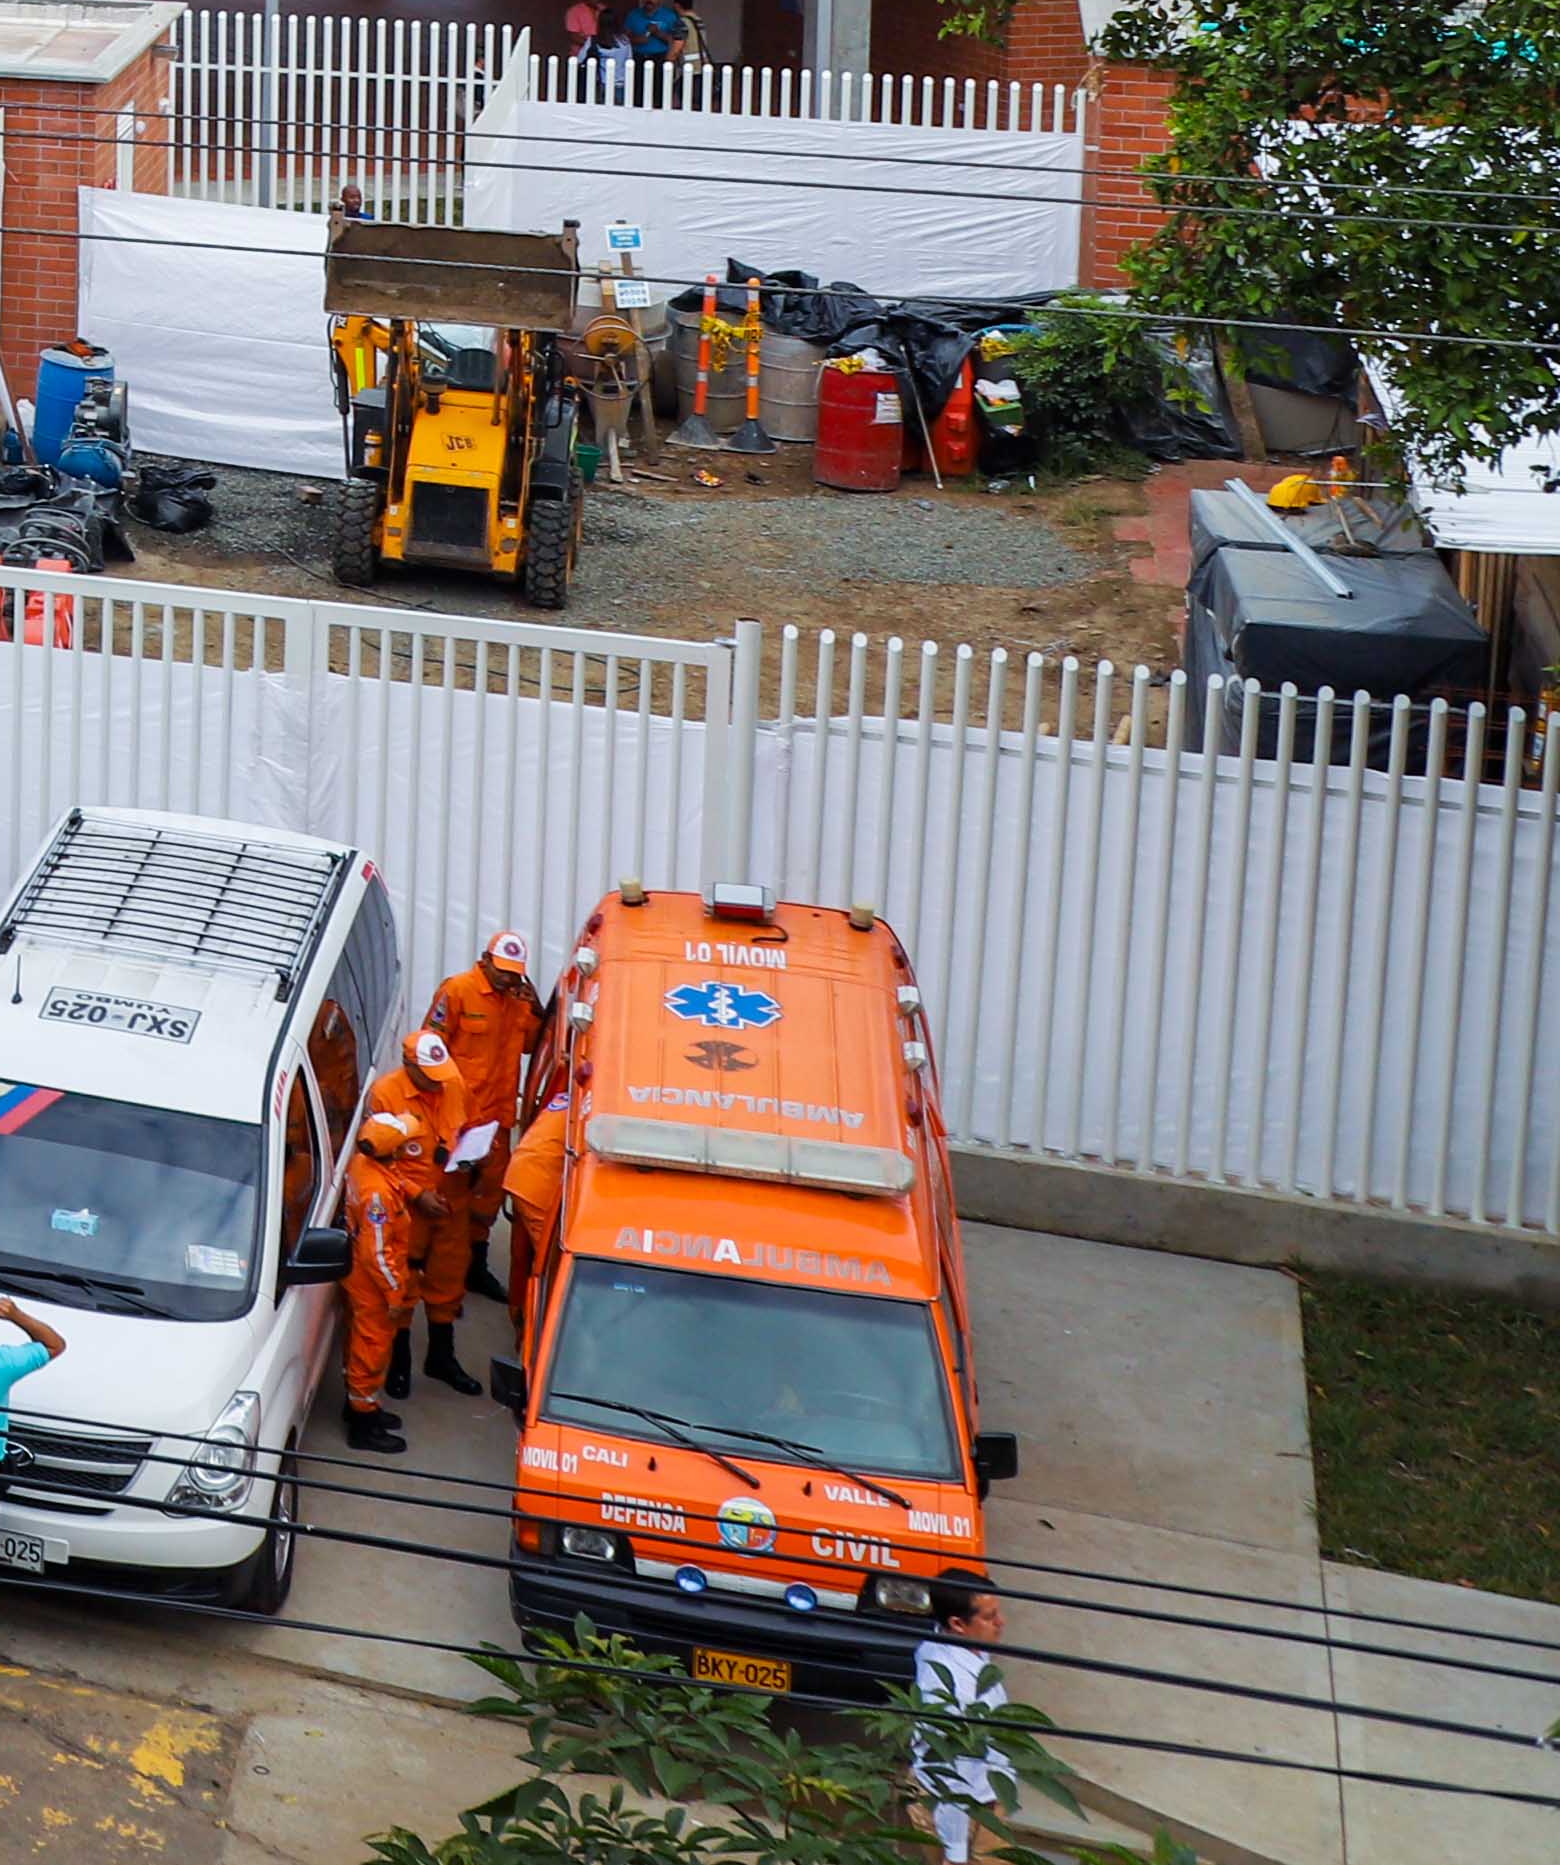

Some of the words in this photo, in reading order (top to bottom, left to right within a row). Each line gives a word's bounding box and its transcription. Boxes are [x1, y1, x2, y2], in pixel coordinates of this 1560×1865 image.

[446, 434, 473, 451] JCB
[684, 939, 712, 963] 01
[75, 993, 173, 1015] YUMBO
[627, 1085, 865, 1129] AMBULANCIA
[523, 1445, 559, 1471] MOVIL
[561, 1454, 578, 1475] 01
[582, 1444, 629, 1469] CALI
[824, 1484, 891, 1509] VALLE
[601, 1492, 687, 1535] DEFENSA
[908, 1510, 953, 1537] MOVIL
[954, 1516, 971, 1539] 01
[811, 1527, 901, 1569] CIVIL
[697, 1654, 787, 1690] BKY-025
